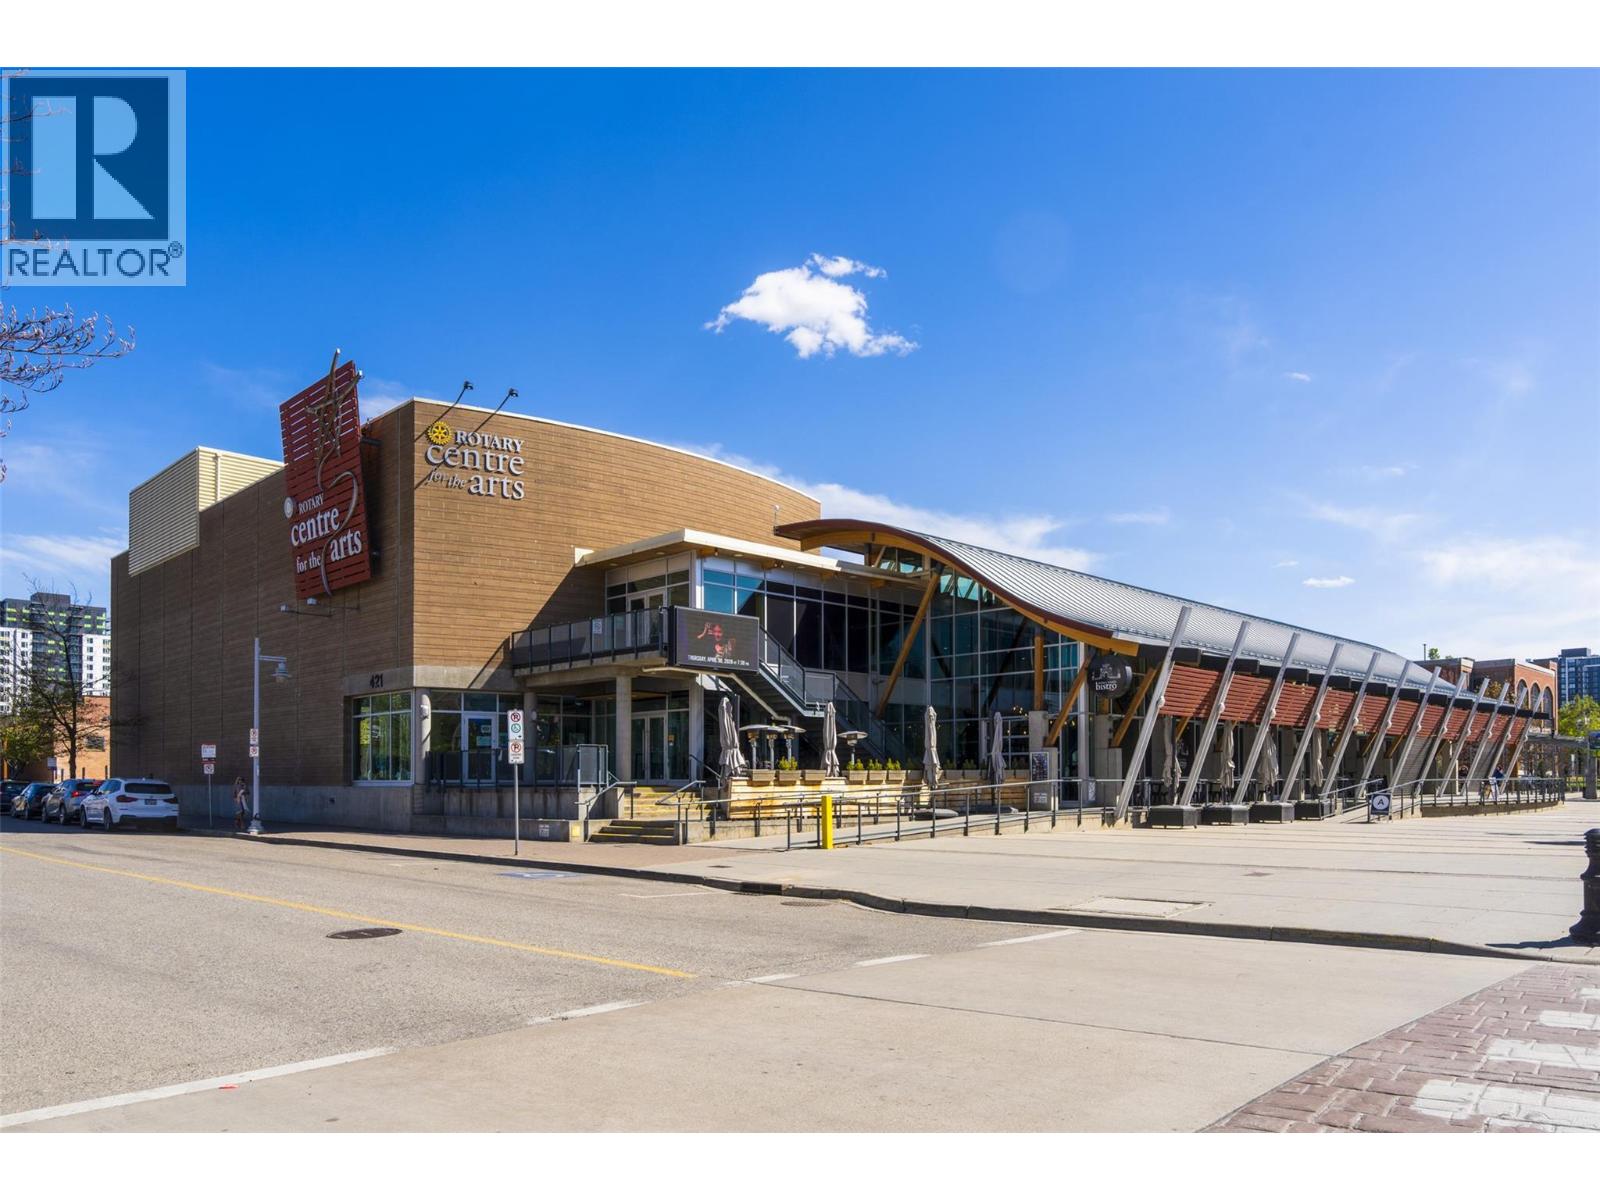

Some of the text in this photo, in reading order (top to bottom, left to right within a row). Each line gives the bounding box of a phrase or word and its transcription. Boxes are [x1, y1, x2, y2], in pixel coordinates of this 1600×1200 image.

[455, 430, 525, 453] ROTARY
[426, 445, 525, 475] centre
[427, 469, 525, 500] for the arts
[298, 493, 324, 514] ROTARY
[291, 508, 341, 547] centre
[296, 529, 362, 574] for the arts
[369, 672, 384, 689] 421
[1095, 681, 1118, 692] bistro
[1377, 798, 1385, 806] A
